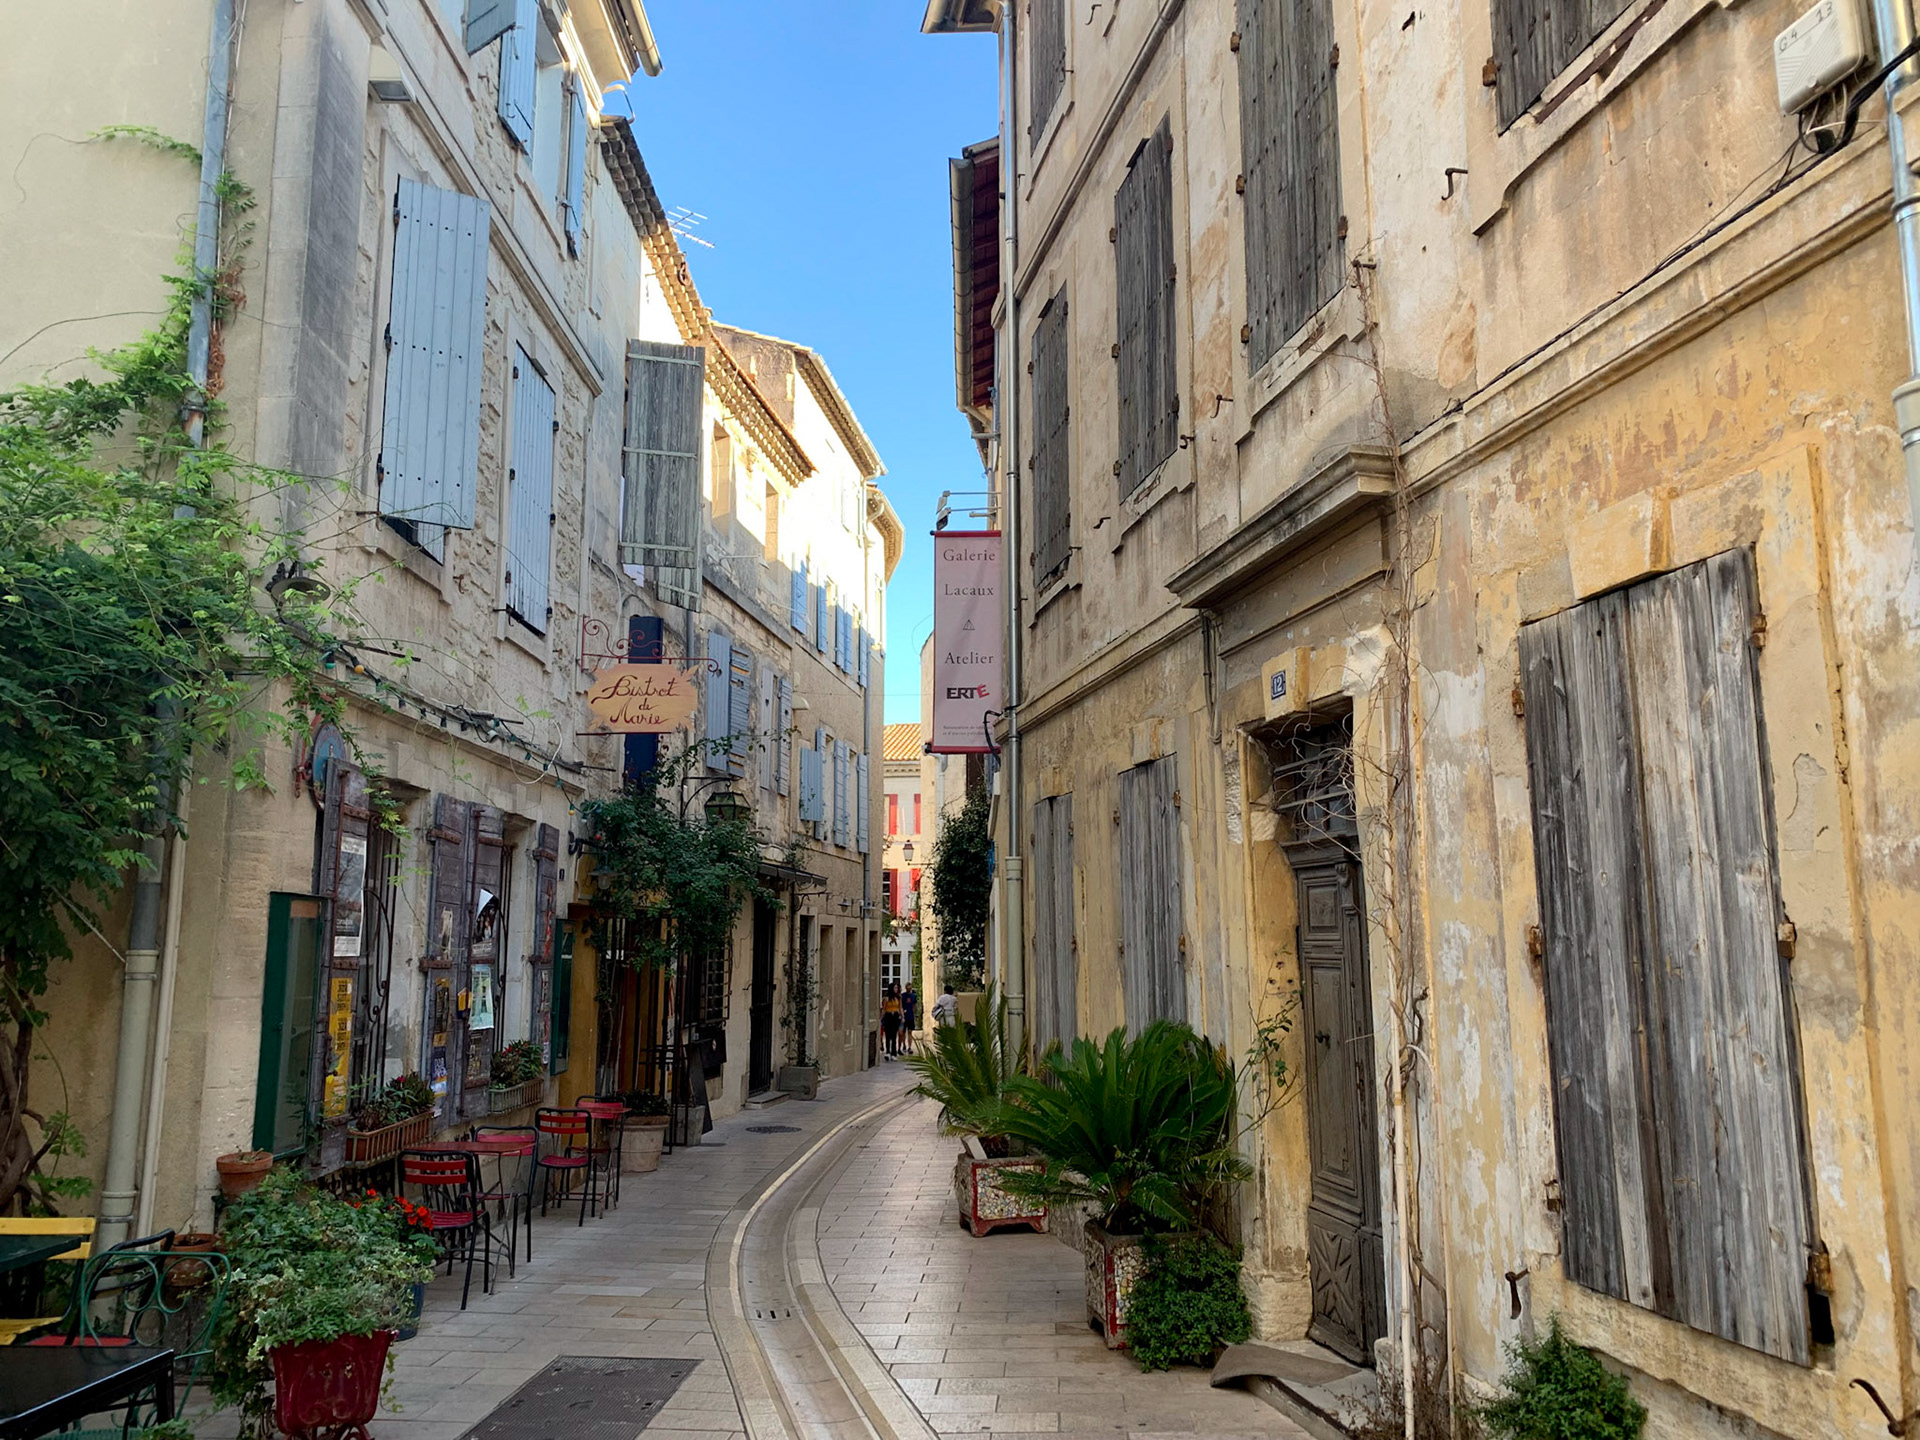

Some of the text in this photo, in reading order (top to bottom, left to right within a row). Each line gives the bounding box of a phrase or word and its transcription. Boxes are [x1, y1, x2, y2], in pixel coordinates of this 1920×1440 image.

[943, 548, 996, 562] Galerie
[944, 584, 994, 597] Lacaux
[944, 652, 994, 665] Atelier
[591, 674, 680, 704] Bistrot
[1273, 676, 1283, 693] 12
[609, 697, 669, 725] Marie
[638, 697, 659, 711] de
